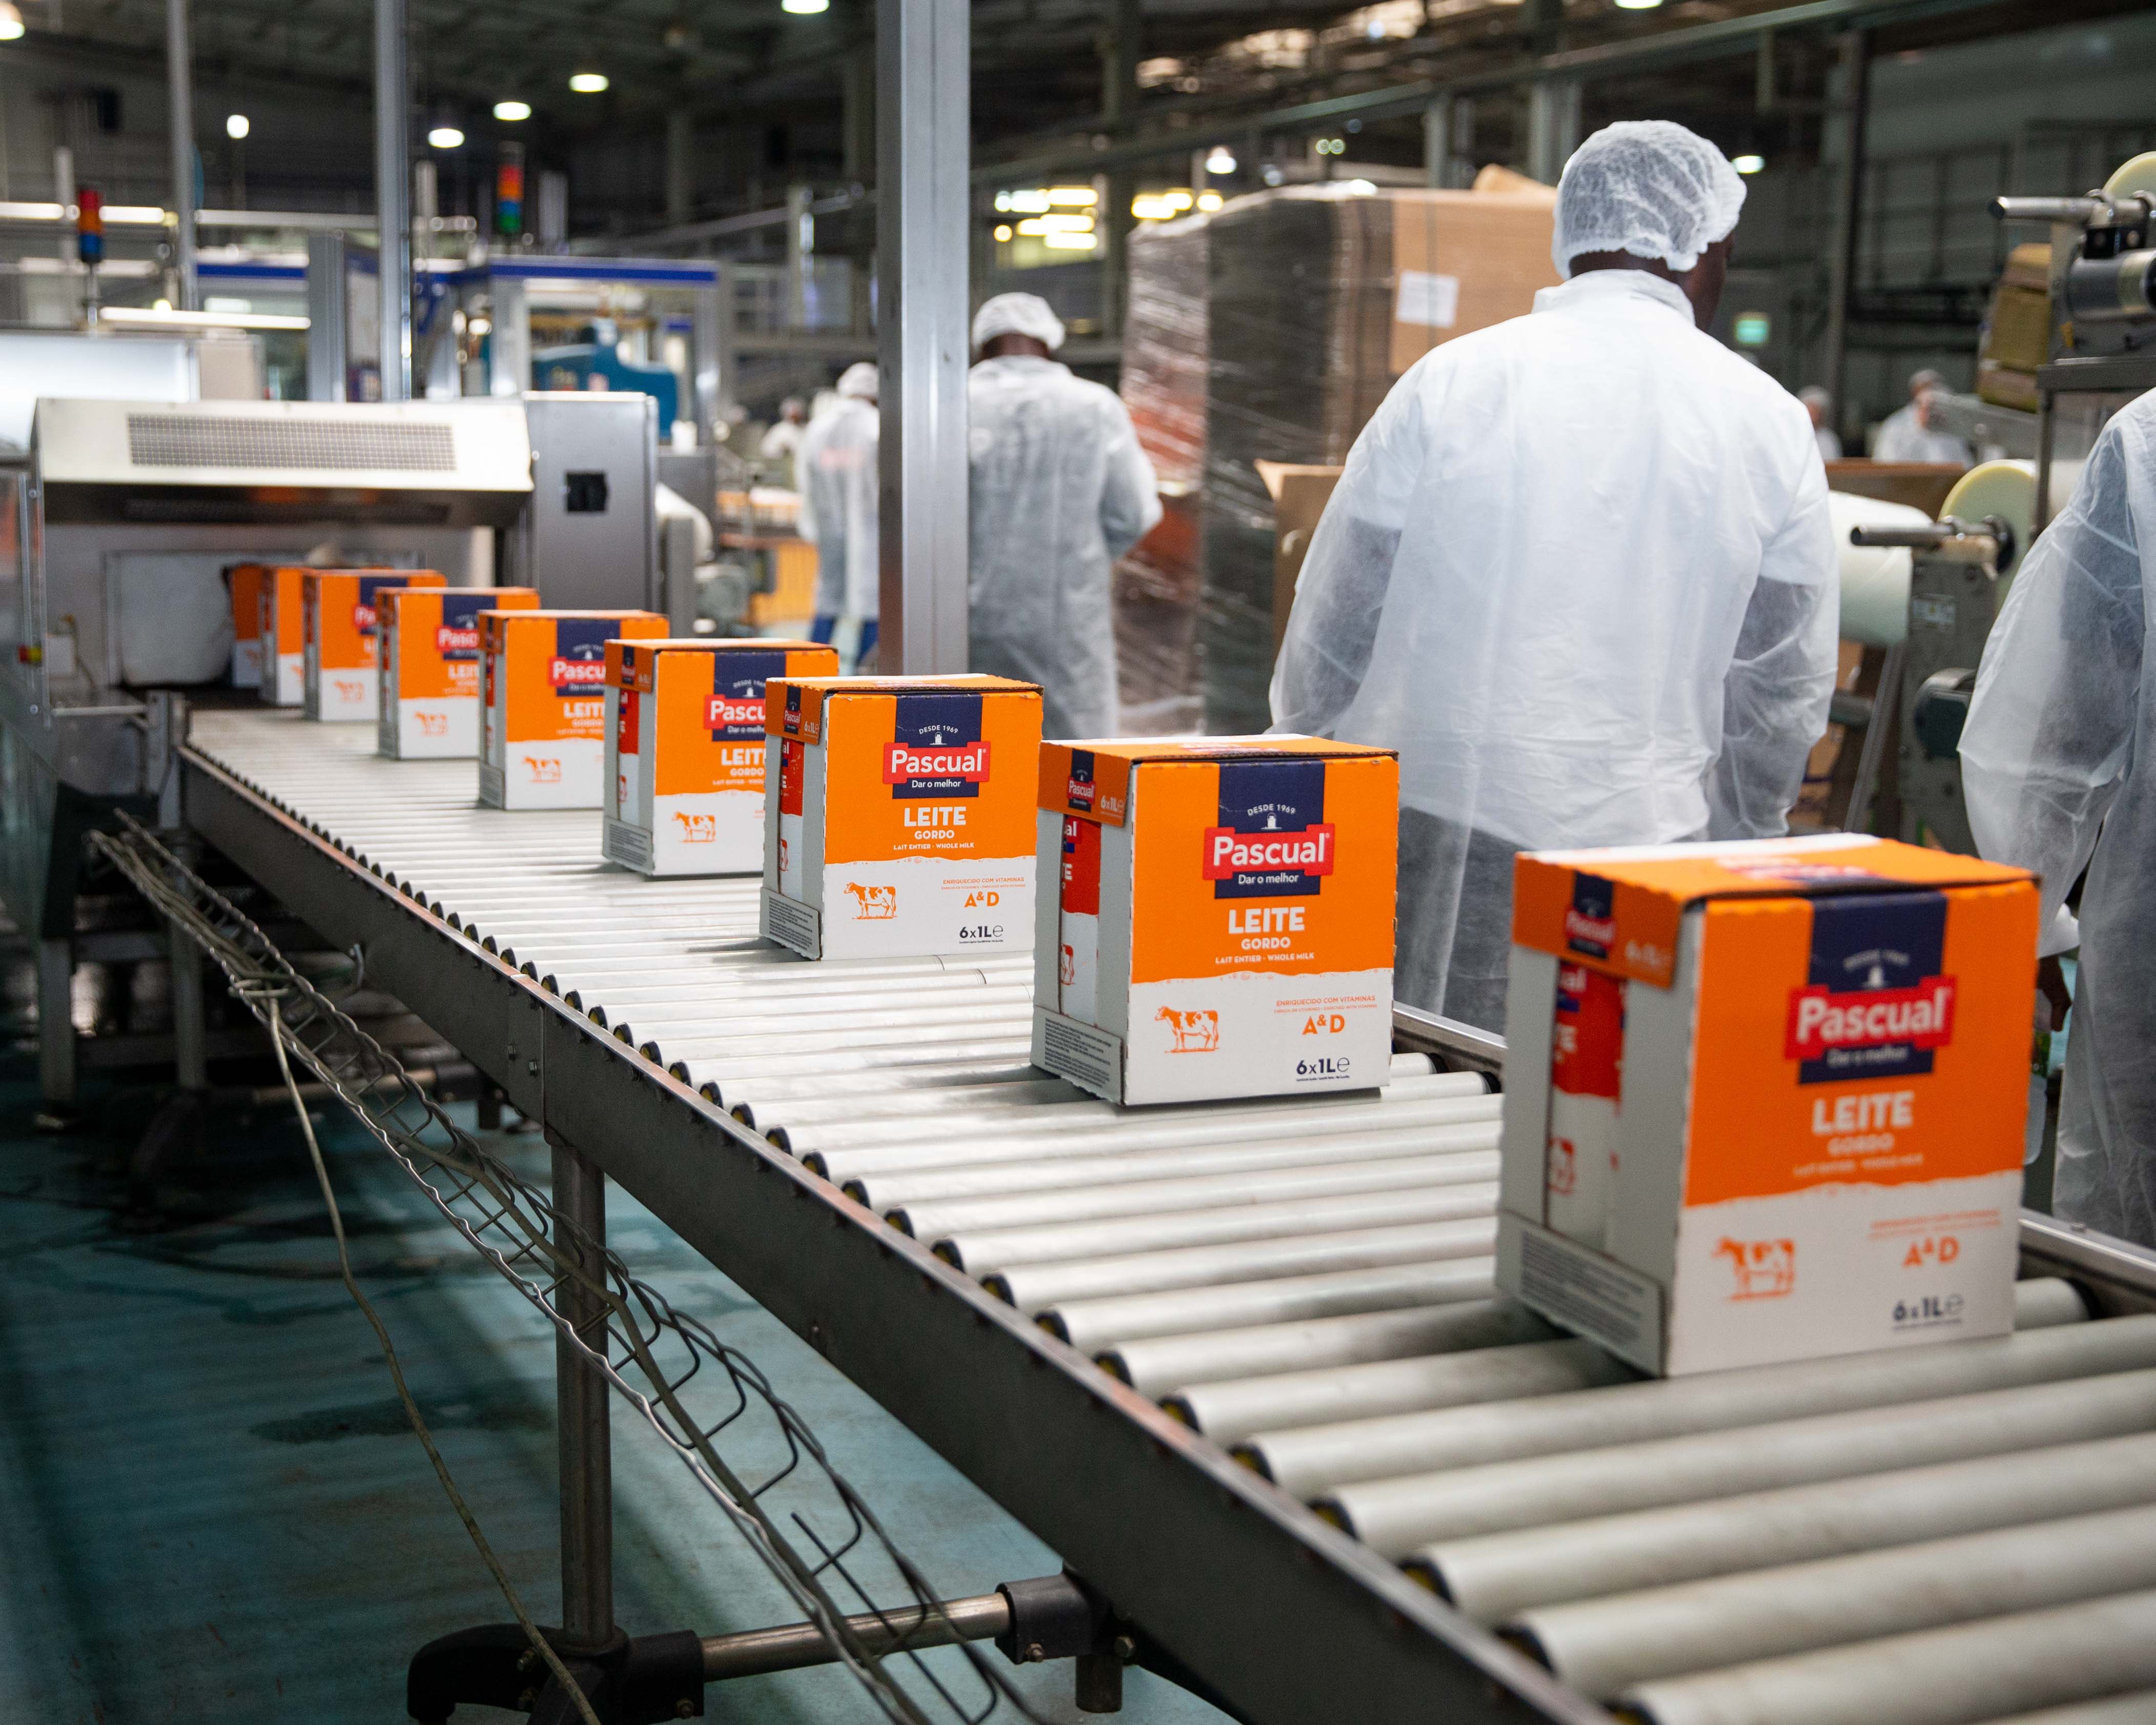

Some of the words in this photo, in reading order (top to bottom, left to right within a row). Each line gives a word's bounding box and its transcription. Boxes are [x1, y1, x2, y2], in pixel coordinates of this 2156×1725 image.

[784, 710, 801, 724] Pascual
[919, 725, 940, 734] DESDE
[943, 725, 958, 734] 1969
[891, 748, 982, 773] Pascual
[934, 779, 961, 787] melhor
[1069, 779, 1095, 798] Pascual
[904, 807, 967, 827] LEITE
[1247, 804, 1274, 816] DESDE
[1277, 804, 1296, 814] 1969
[914, 830, 955, 839] GORDO
[1214, 833, 1325, 866] Pascual
[1238, 874, 1255, 885] Dar
[1257, 876, 1263, 884] o
[1265, 872, 1299, 883] melhor
[1228, 907, 1305, 934] LEITE
[1241, 936, 1291, 950] GORDO
[1276, 998, 1321, 1007] ENRIQUECIDO
[1796, 986, 1948, 1044] Pascual
[1812, 1090, 1915, 1136] LEITE
